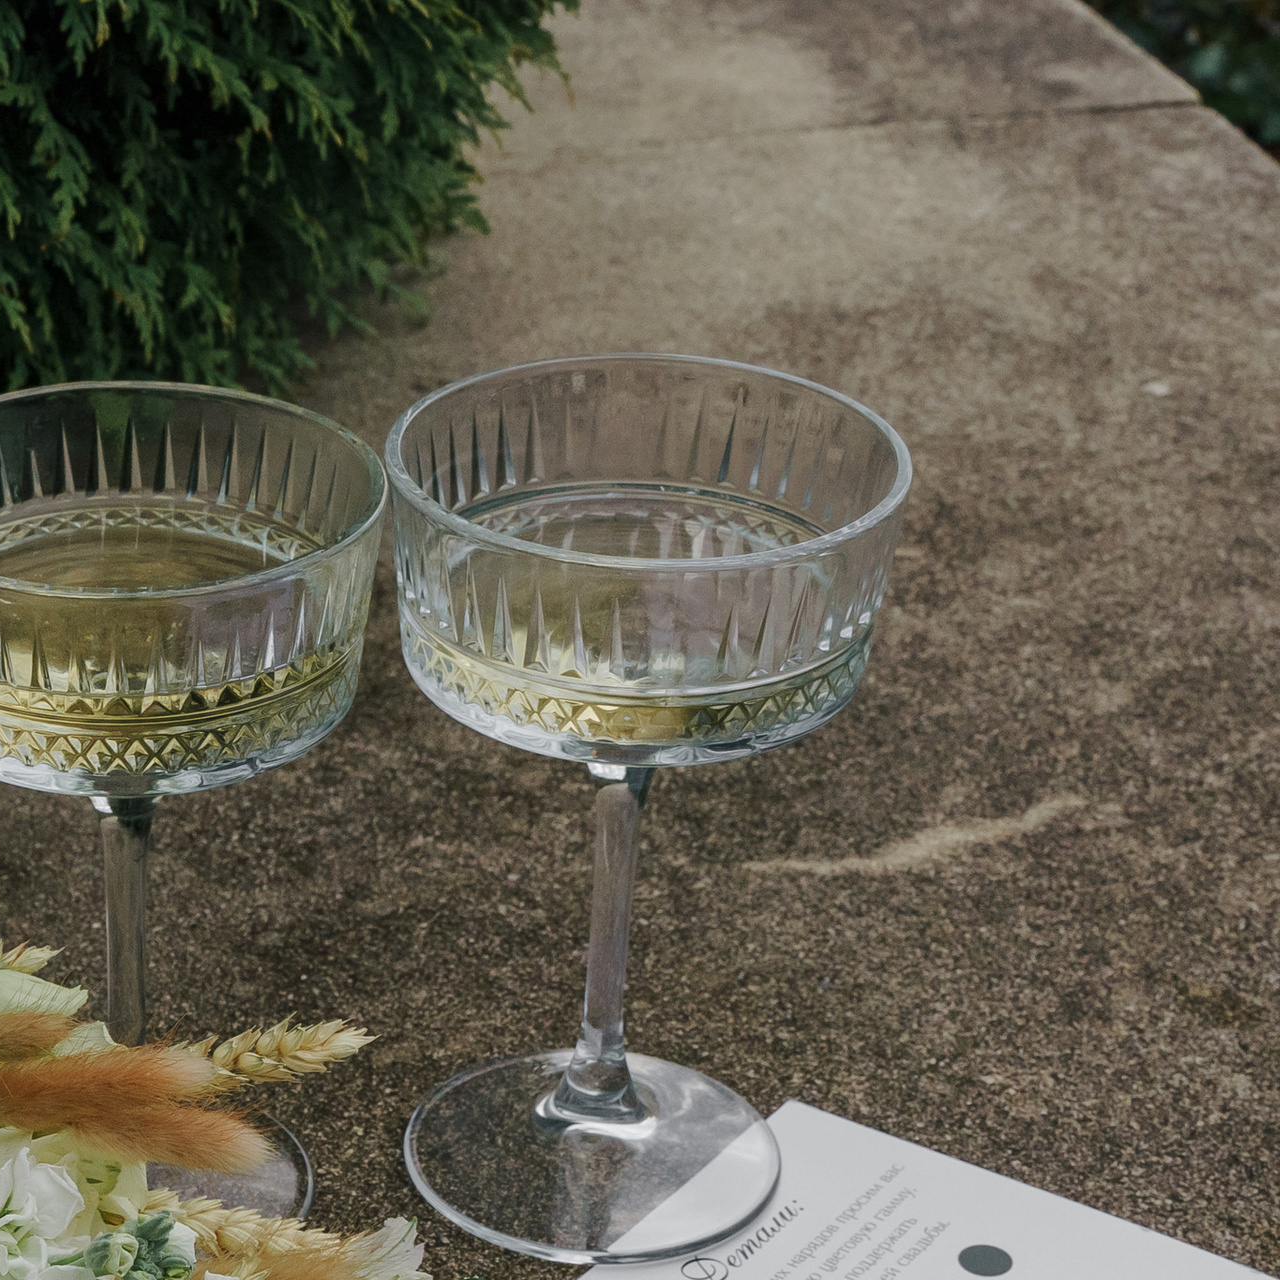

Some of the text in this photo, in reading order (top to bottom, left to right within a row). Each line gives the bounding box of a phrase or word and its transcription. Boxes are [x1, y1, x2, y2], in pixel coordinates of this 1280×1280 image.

[786, 1224, 840, 1269] нарядов
[834, 1183, 884, 1225] просим
[878, 1163, 906, 1184] вас
[818, 1221, 878, 1273] цветовую
[872, 1186, 918, 1222] гамму,
[896, 1221, 951, 1267] свадьбы.
